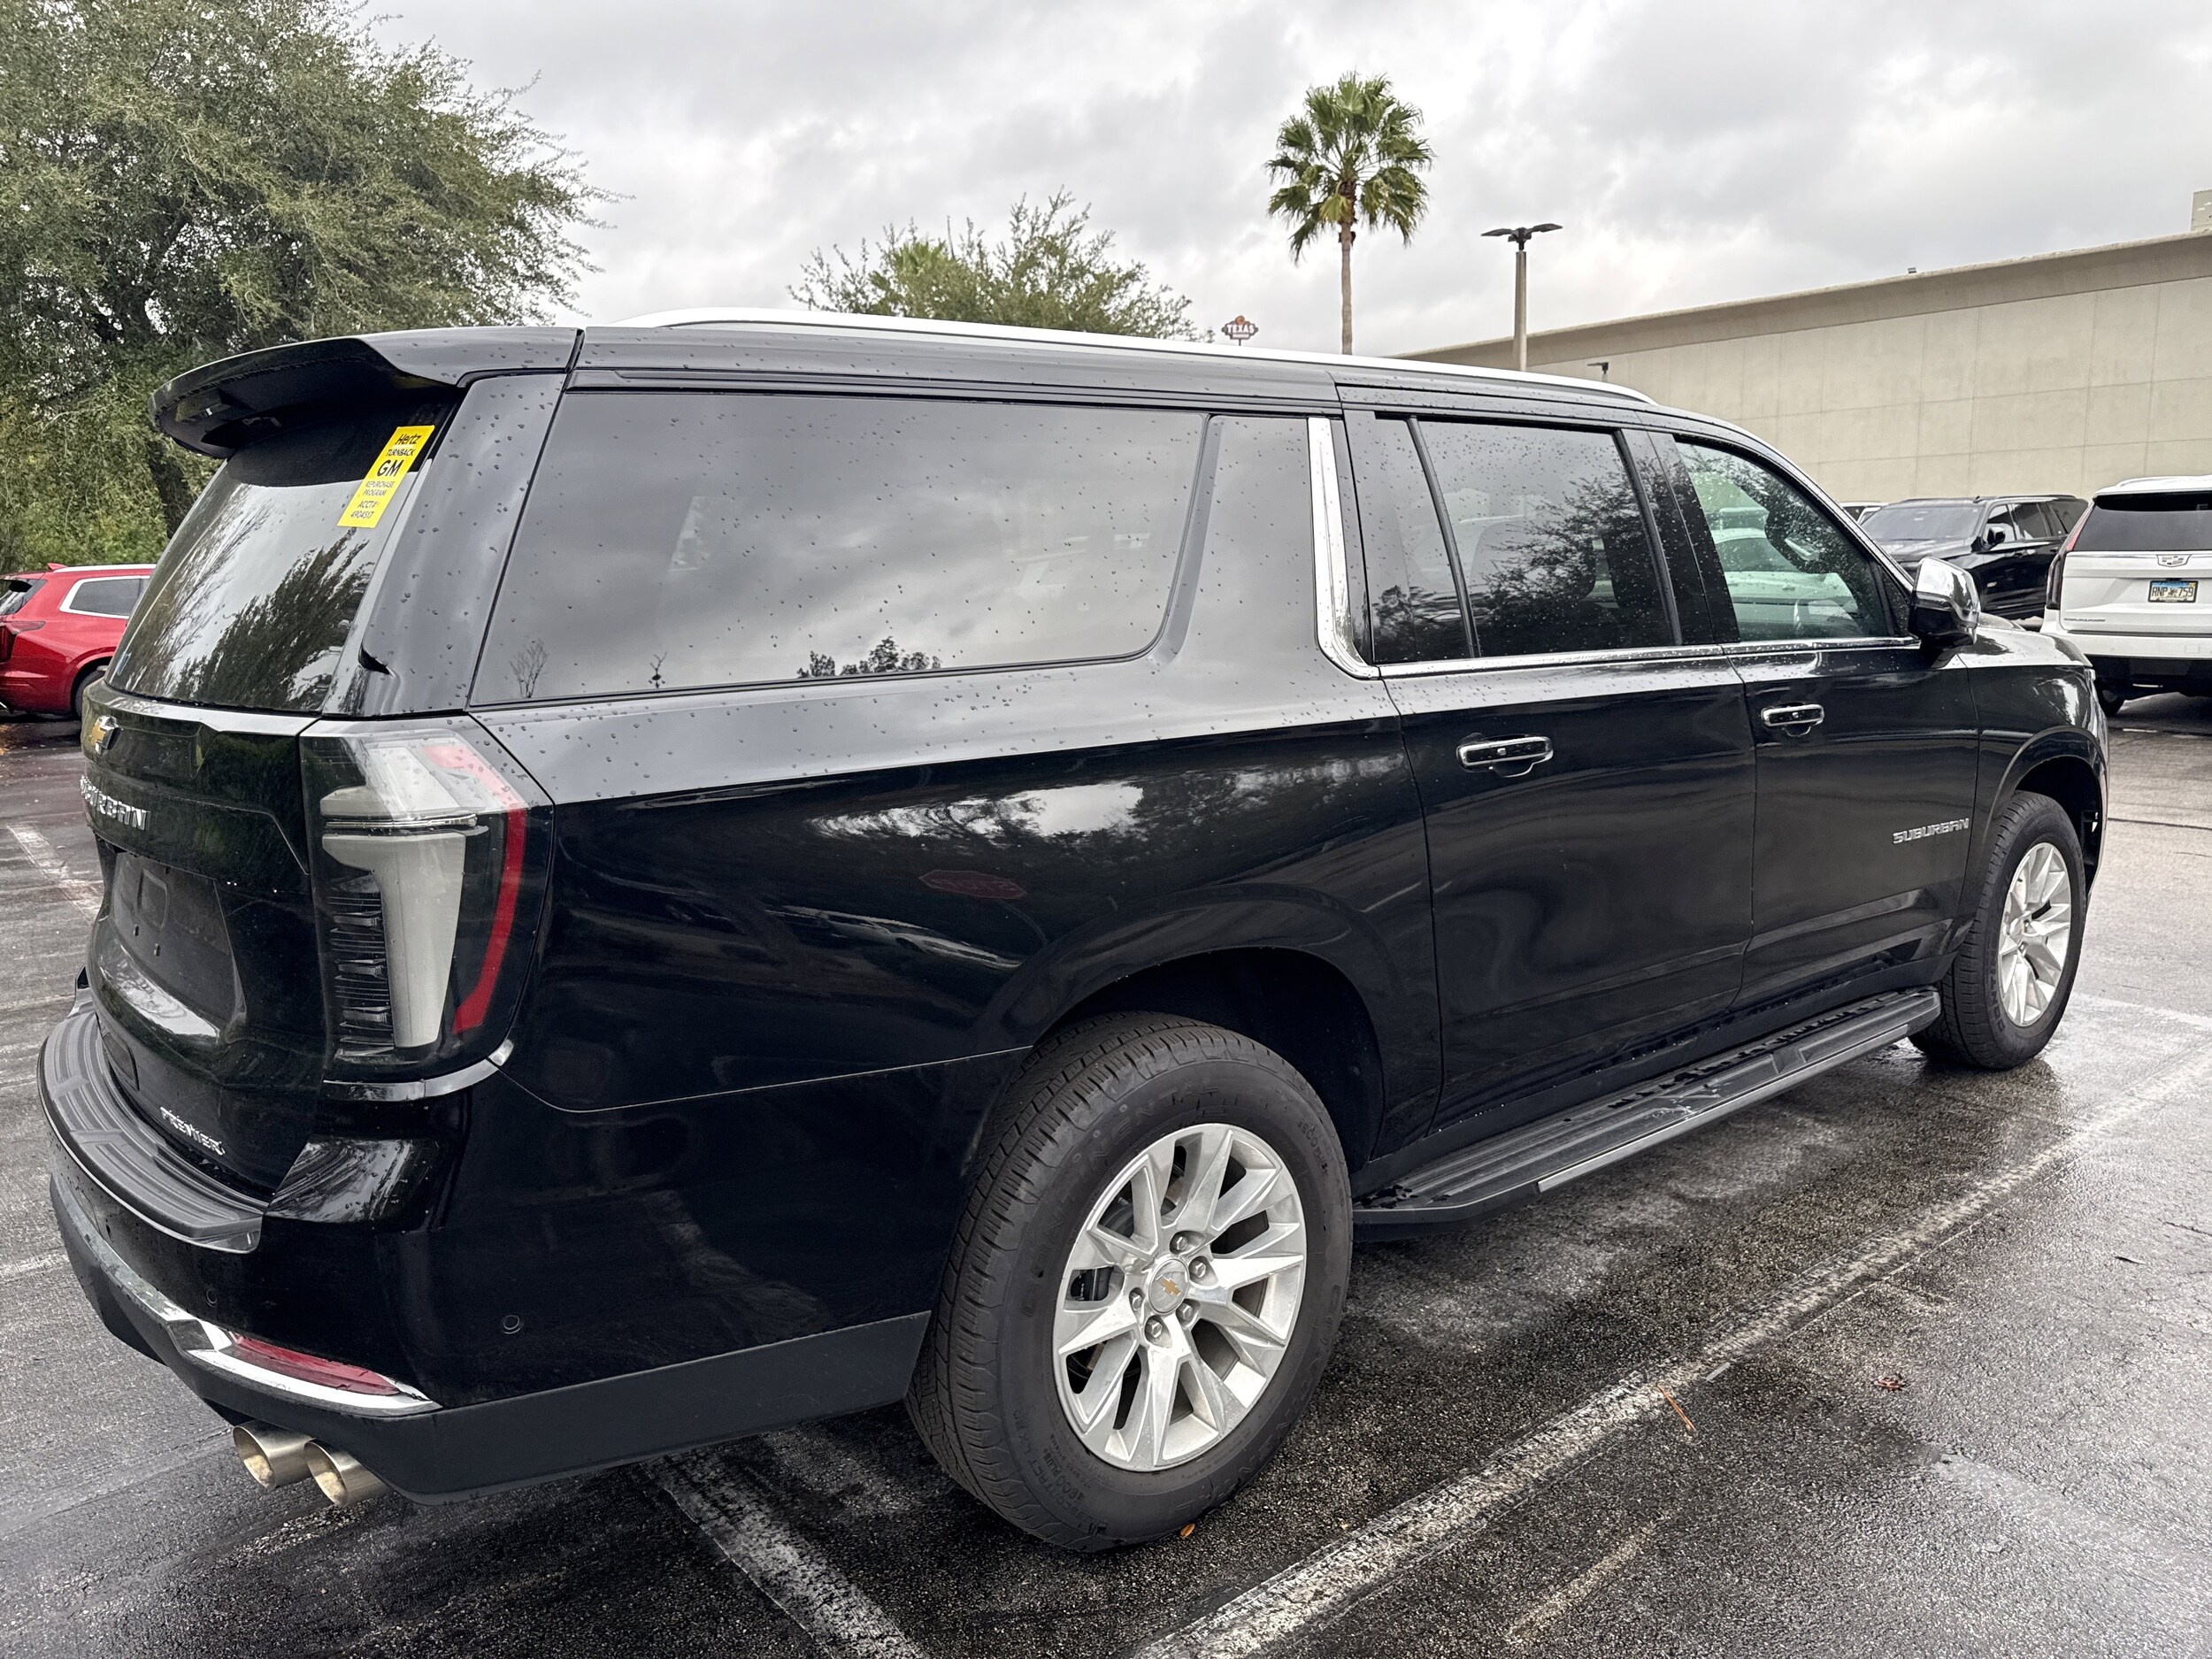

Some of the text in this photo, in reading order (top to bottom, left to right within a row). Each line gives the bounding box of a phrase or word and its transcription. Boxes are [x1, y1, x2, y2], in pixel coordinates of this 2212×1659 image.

[395, 434, 422, 445] Hertz
[377, 459, 404, 477] GM
[2152, 587, 2193, 597] RNP 759
[1893, 818, 1969, 843] SUBURBAN
[160, 1107, 226, 1155] PREMIER
